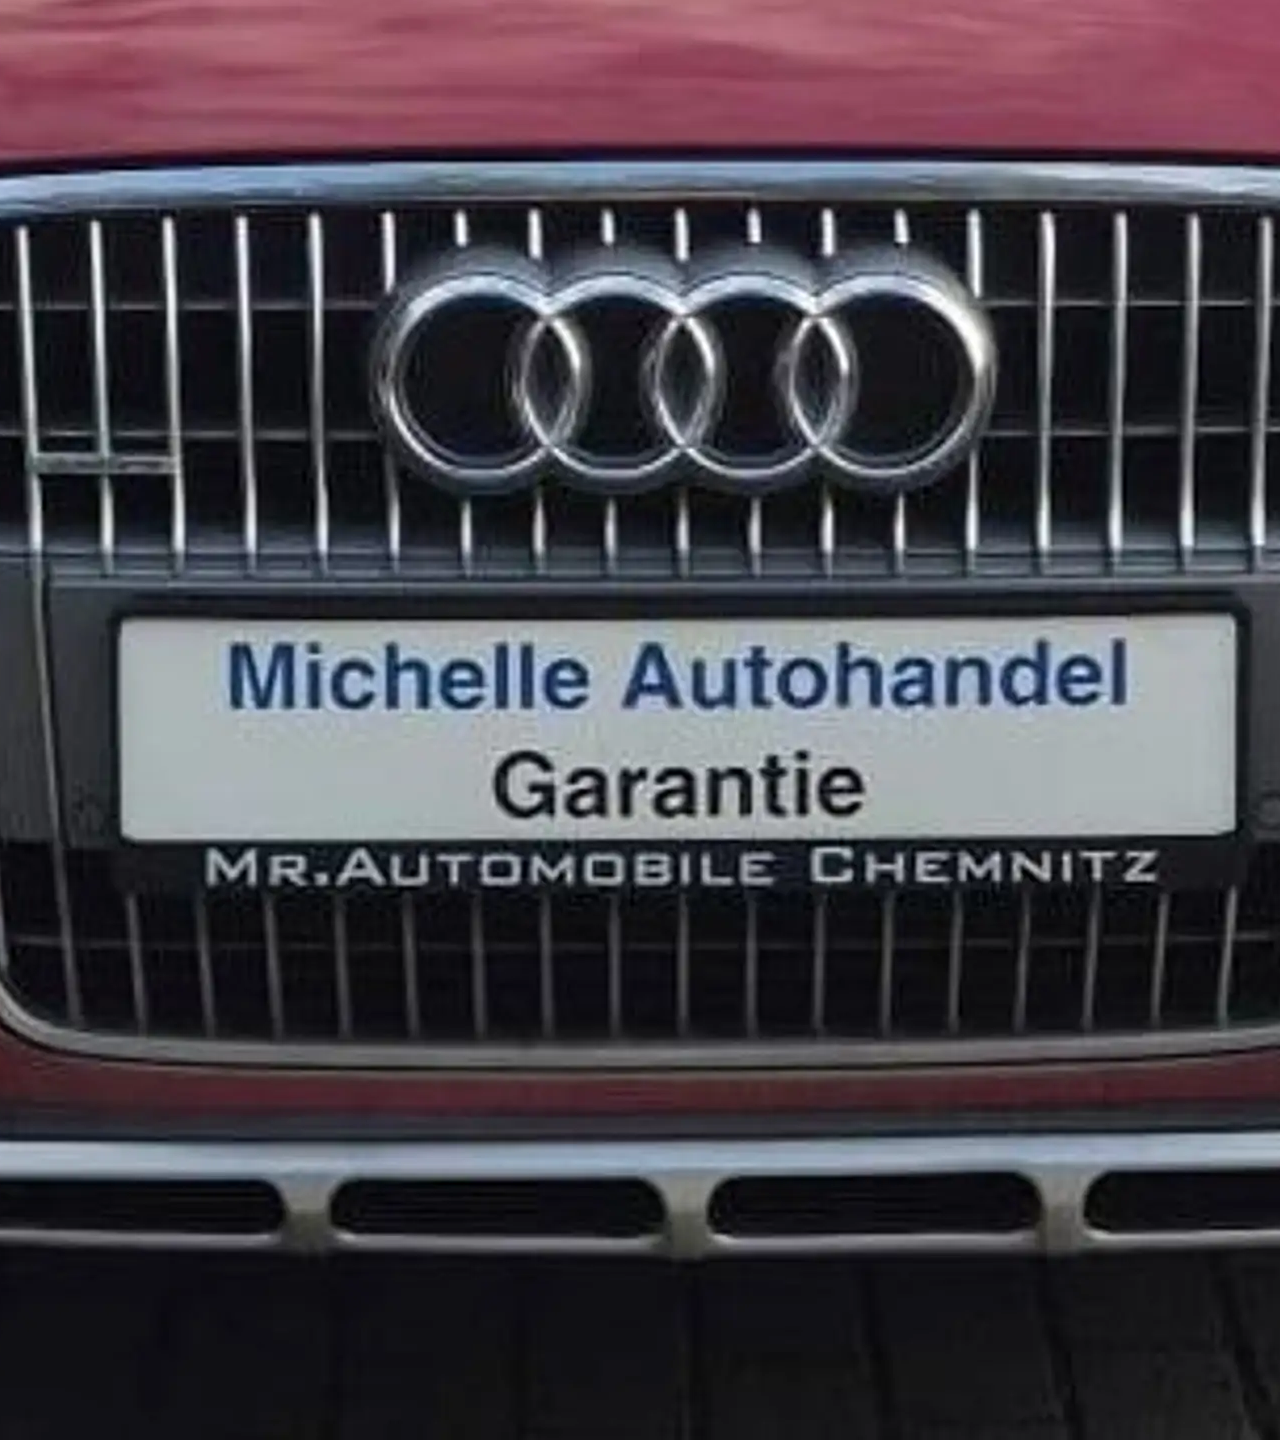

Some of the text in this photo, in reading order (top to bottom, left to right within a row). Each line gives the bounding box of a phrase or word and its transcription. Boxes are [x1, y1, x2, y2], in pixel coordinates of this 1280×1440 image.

[227, 637, 1129, 712] Michelle Autohandel
[492, 748, 867, 821] Garantie
[809, 845, 1159, 886] CHEMNITZ
